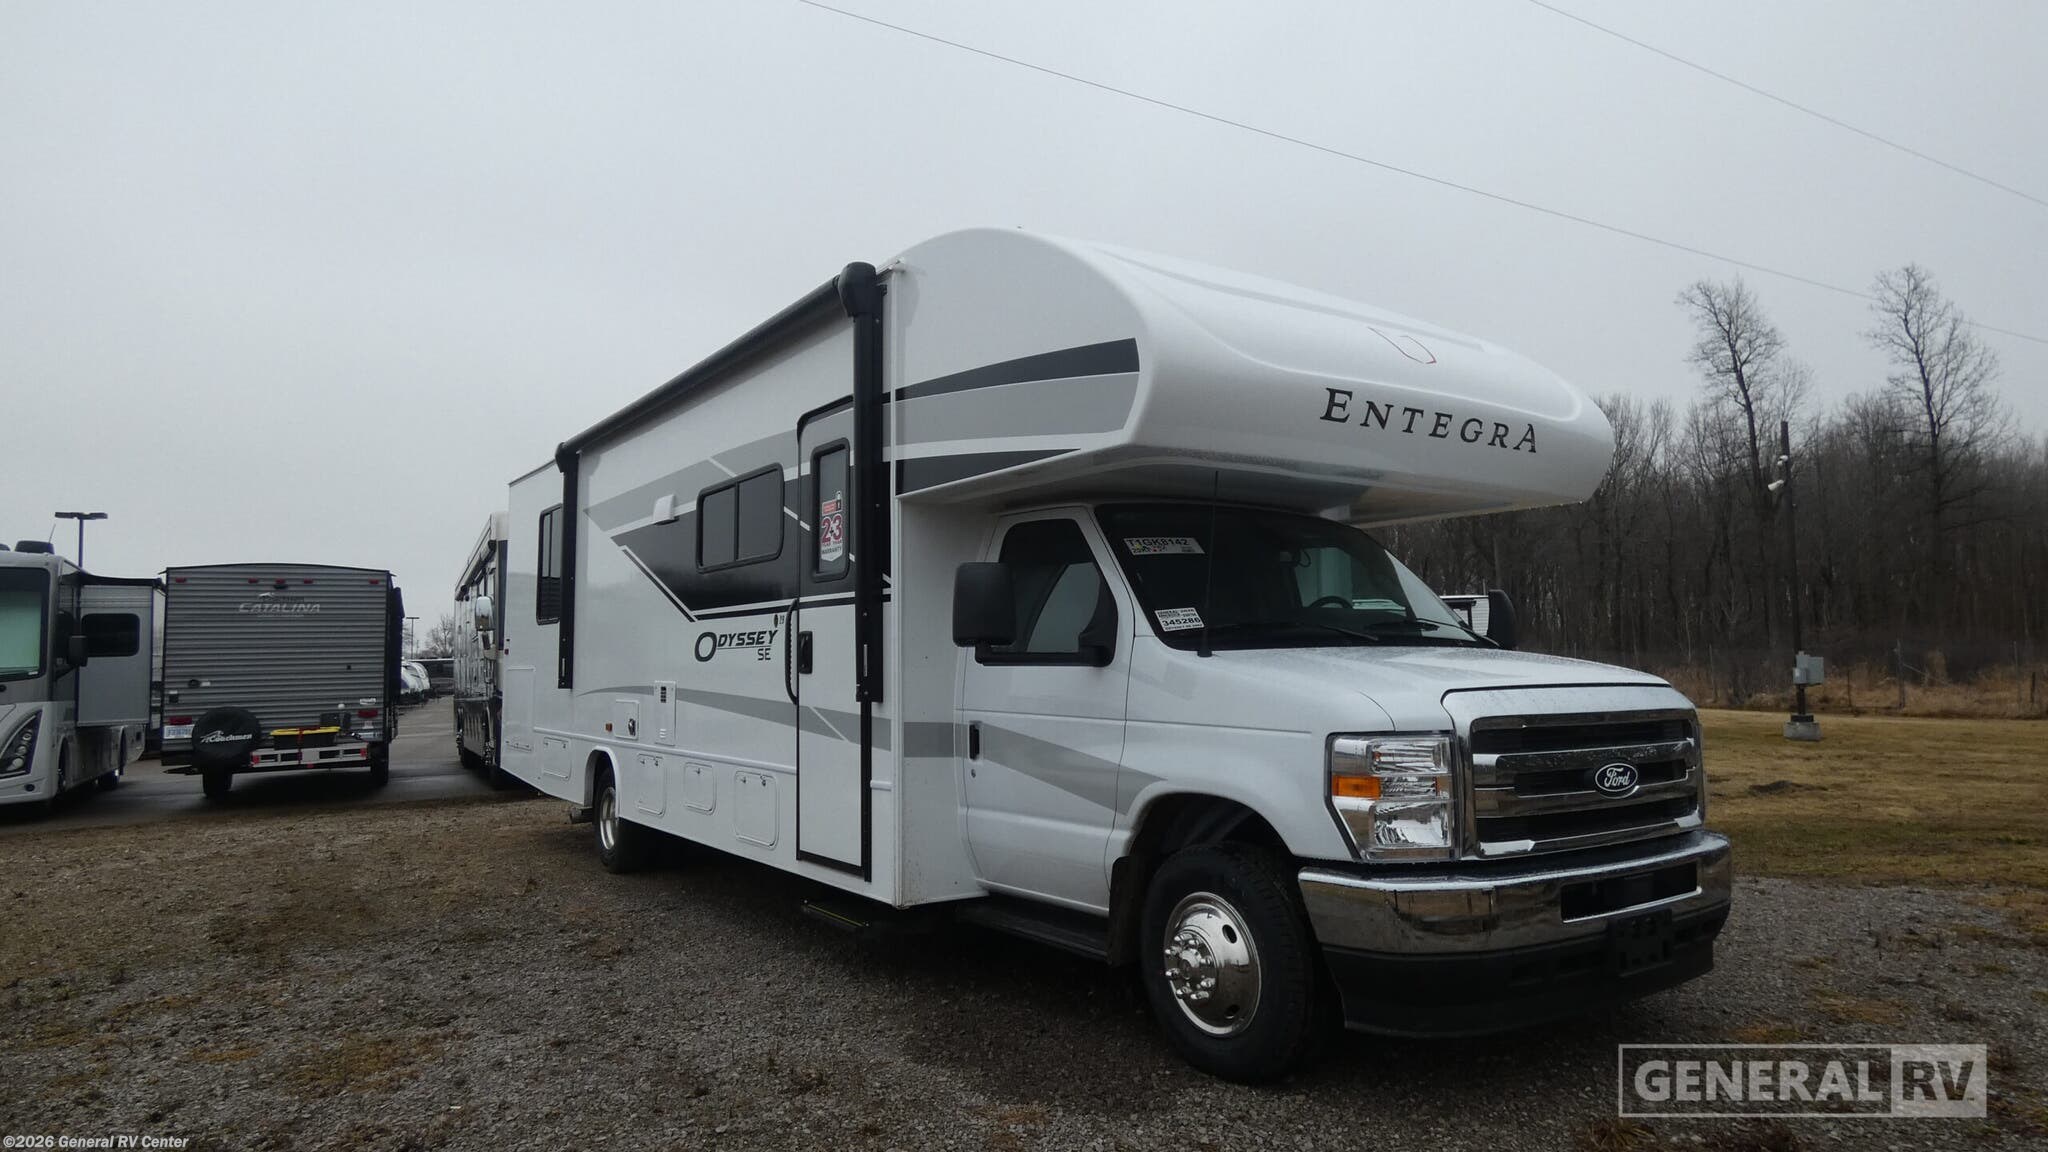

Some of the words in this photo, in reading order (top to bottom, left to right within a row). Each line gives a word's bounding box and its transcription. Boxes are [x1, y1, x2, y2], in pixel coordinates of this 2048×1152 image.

[1320, 387, 1537, 453] ENTEGRA
[238, 603, 321, 613] CATALINA
[1162, 617, 1201, 626] 345286
[694, 630, 778, 662] ODYSSEY
[757, 648, 771, 661] SE
[209, 733, 253, 743] Coachmen
[1604, 767, 1631, 787] Ford
